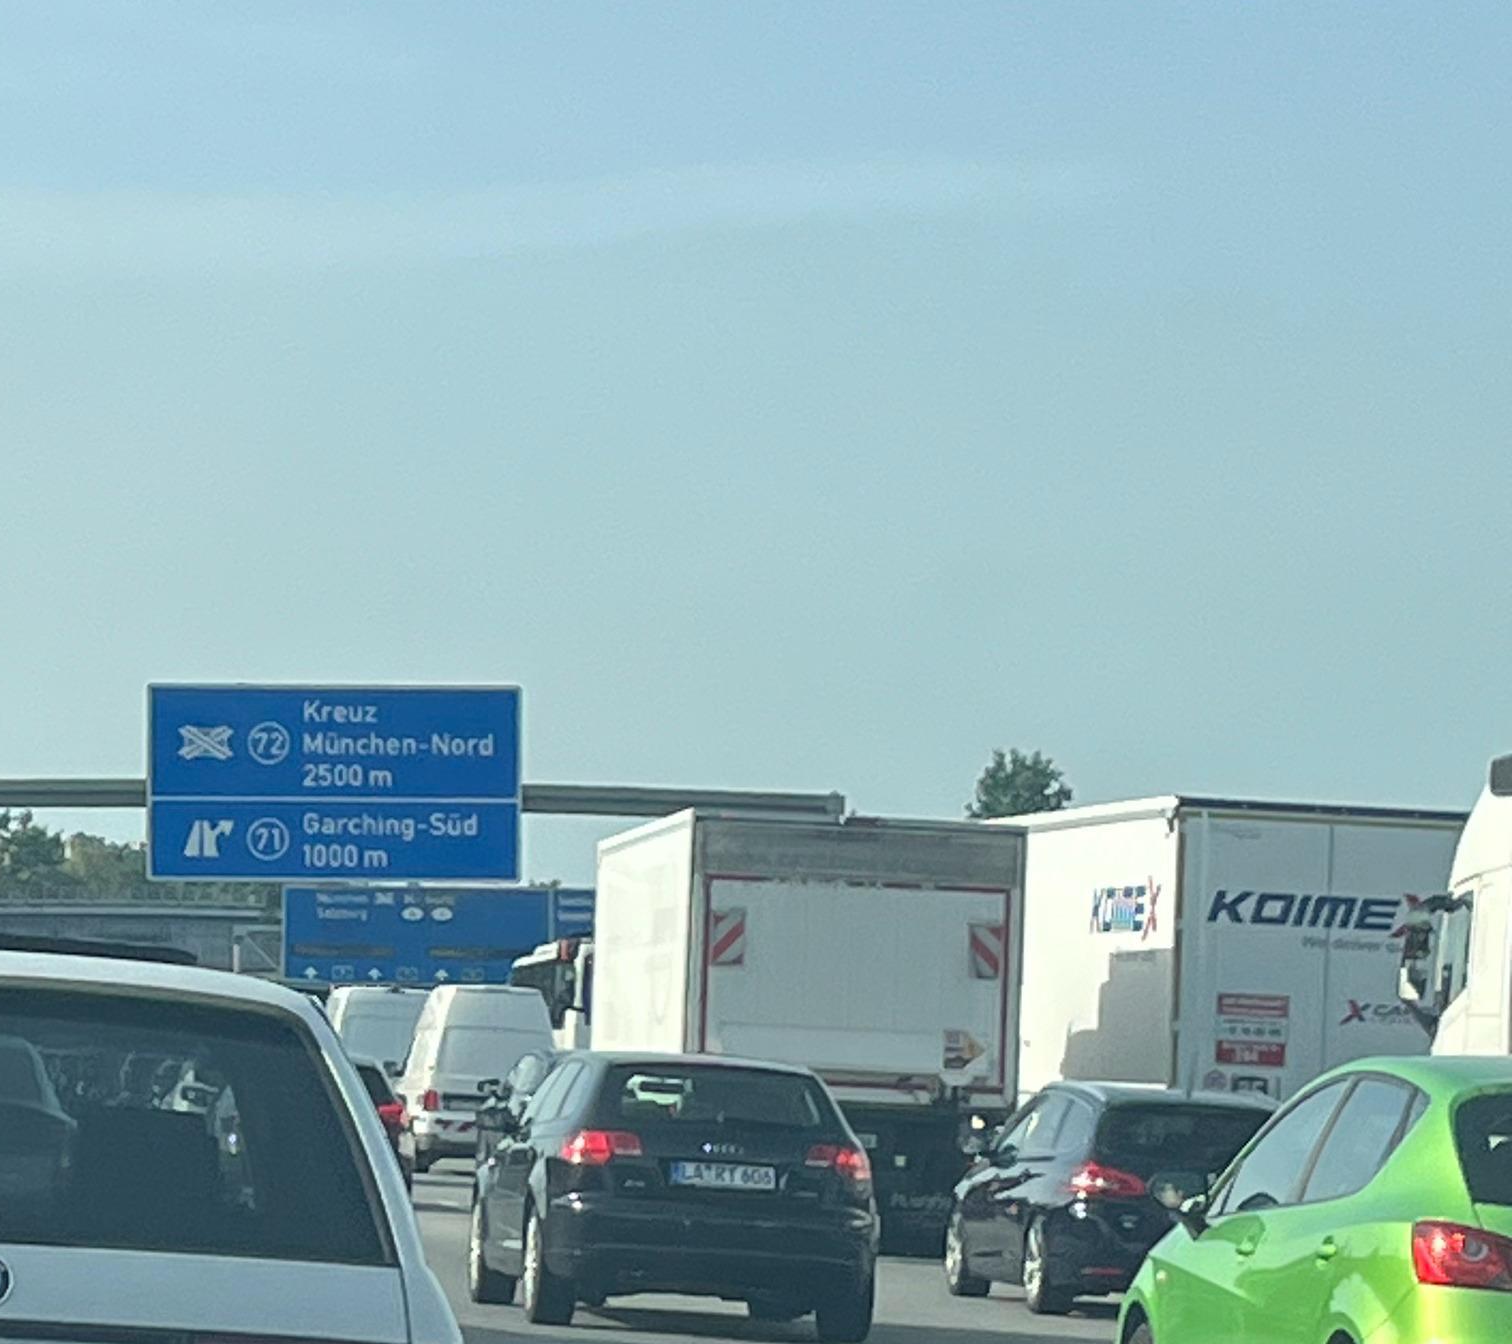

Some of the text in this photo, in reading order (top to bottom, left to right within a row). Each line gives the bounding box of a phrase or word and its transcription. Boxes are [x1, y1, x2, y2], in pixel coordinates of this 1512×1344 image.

[303, 700, 377, 723] Kreuz
[254, 732, 283, 754] 72
[303, 733, 493, 756] München-Nord
[303, 764, 393, 787] 2500 m
[303, 813, 478, 841] Garching-Süd
[254, 828, 282, 851] 71
[303, 844, 387, 868] 1000 m
